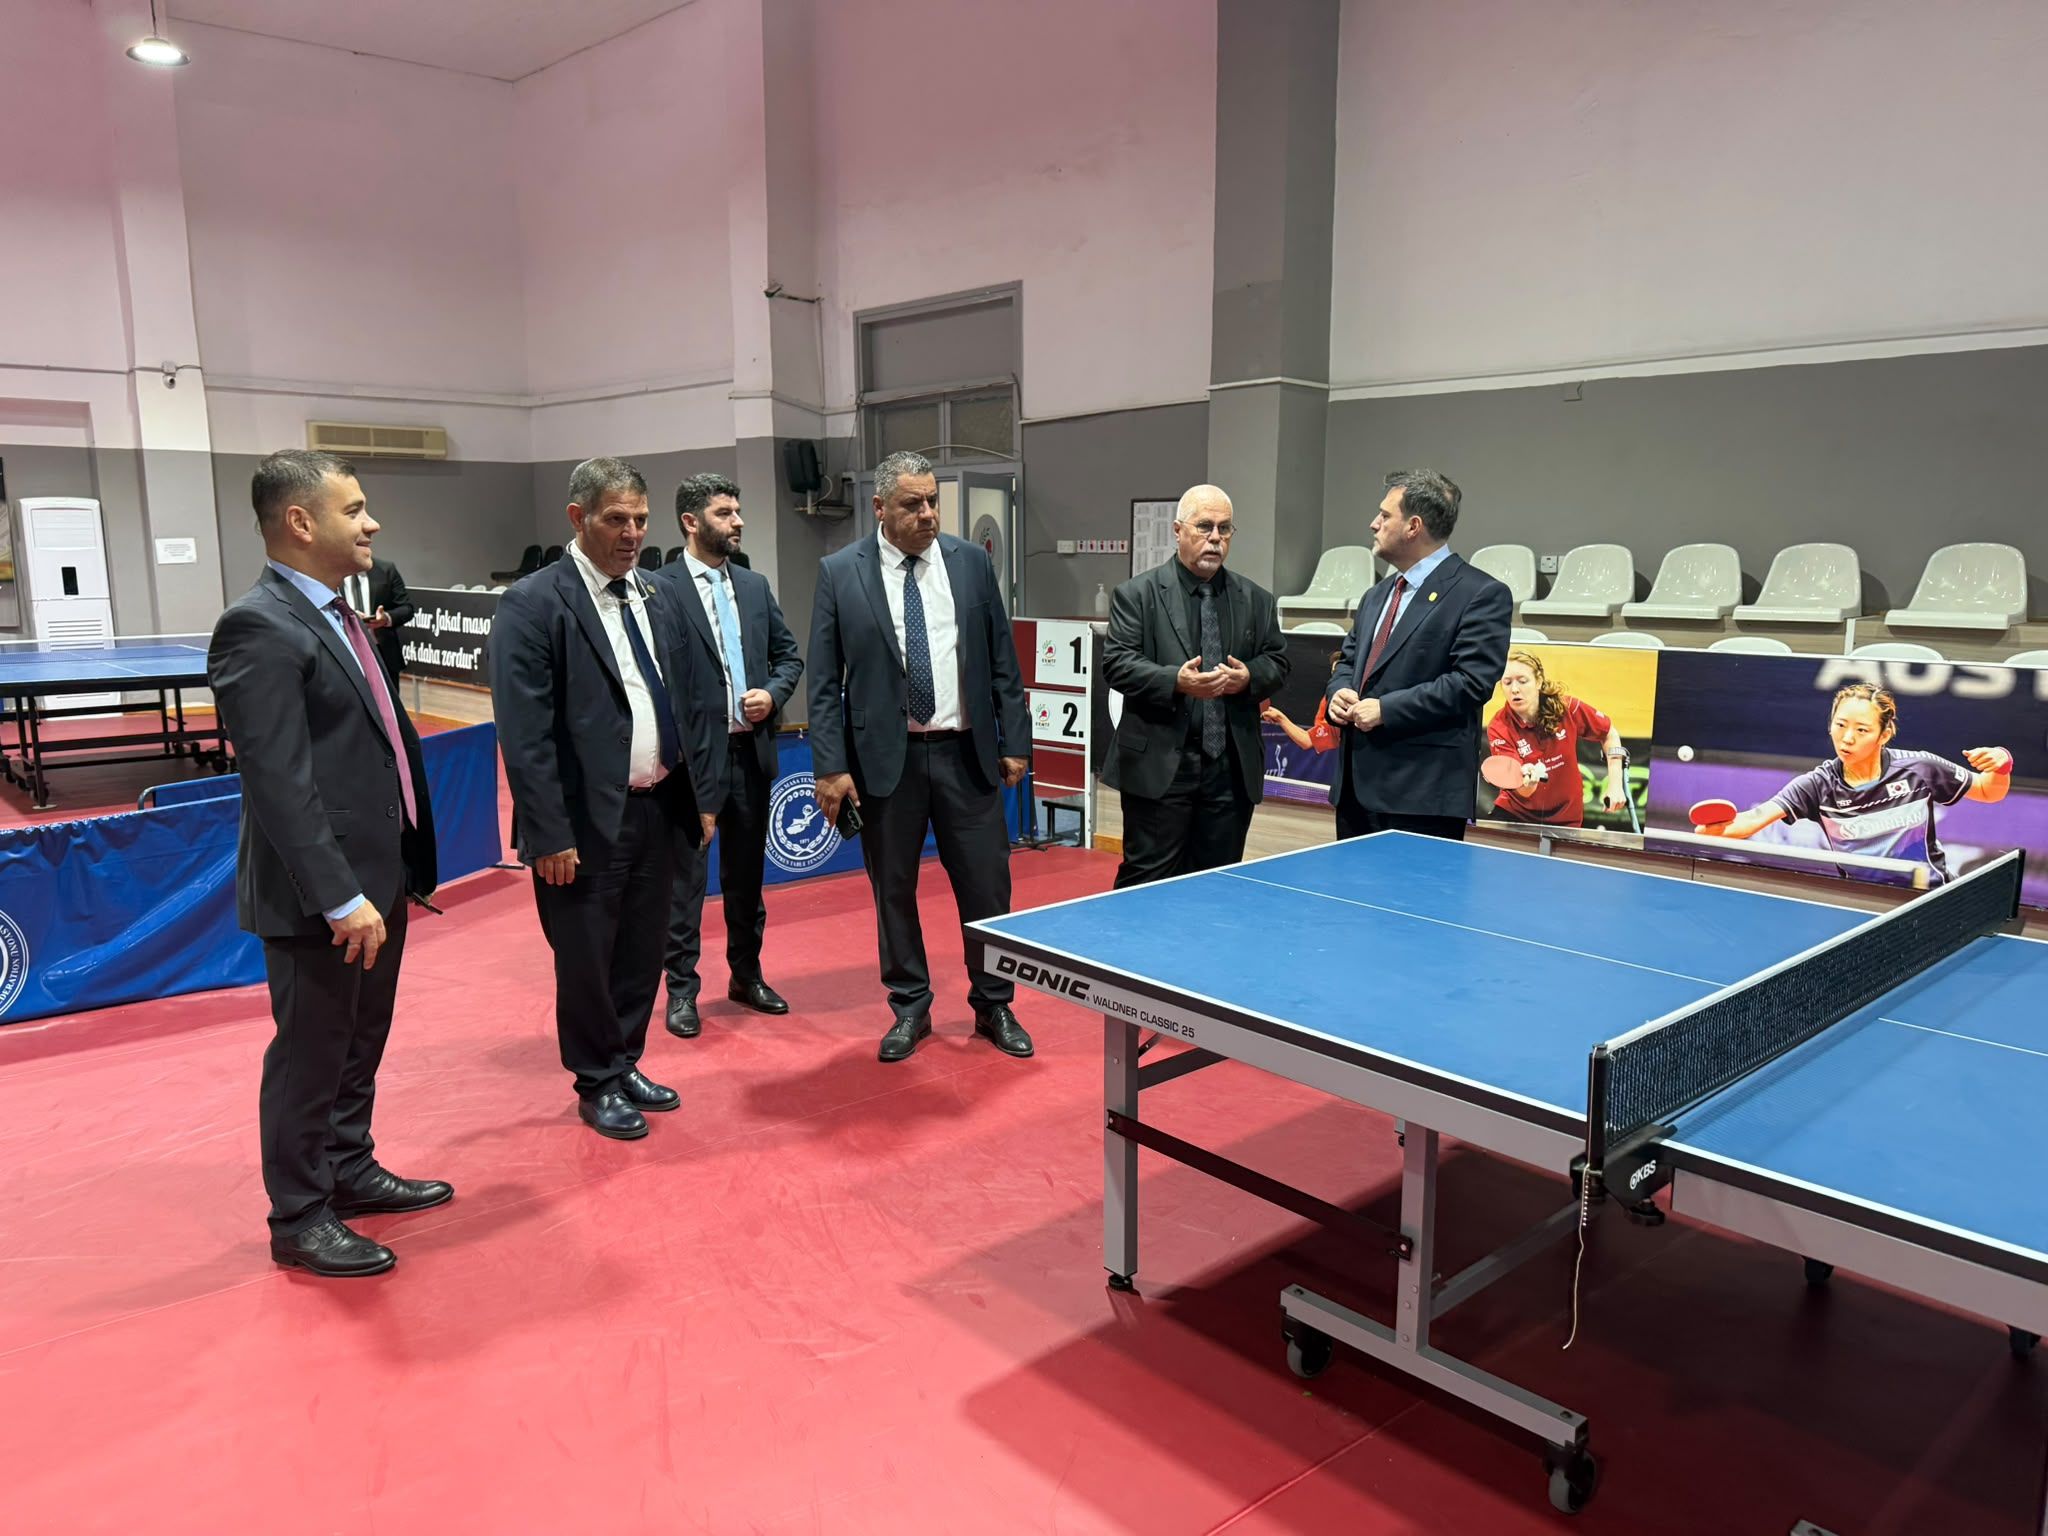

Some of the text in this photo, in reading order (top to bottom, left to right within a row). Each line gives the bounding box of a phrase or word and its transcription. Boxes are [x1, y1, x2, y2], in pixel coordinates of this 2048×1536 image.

[418, 642, 440, 665] daha
[1070, 636, 1087, 674] 1.
[1062, 702, 1083, 738] 2.
[996, 955, 1195, 1038] DONIC WALDNER CLASSIC 25
